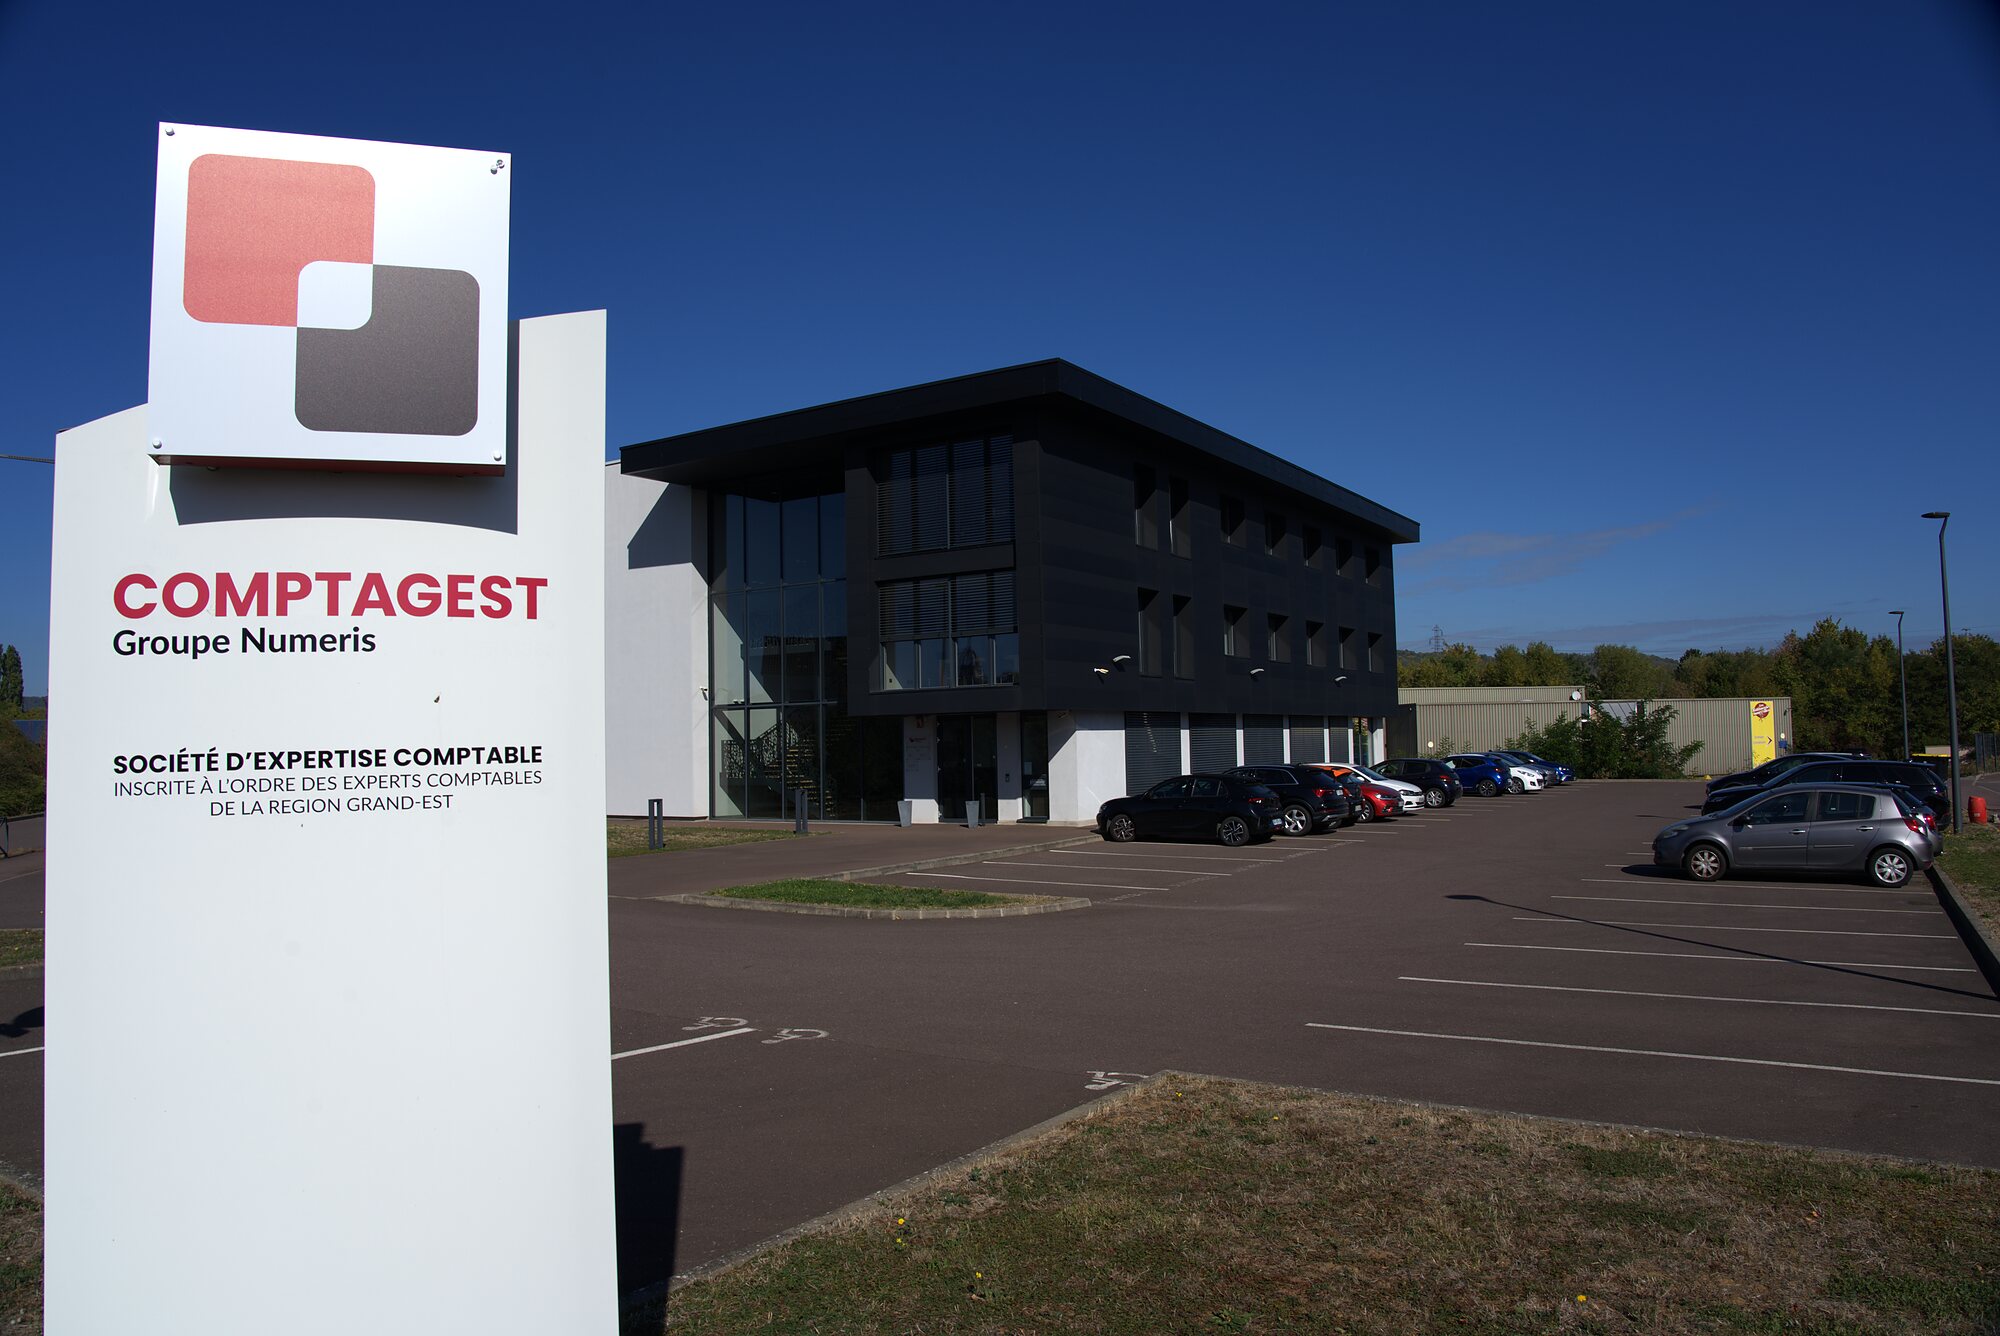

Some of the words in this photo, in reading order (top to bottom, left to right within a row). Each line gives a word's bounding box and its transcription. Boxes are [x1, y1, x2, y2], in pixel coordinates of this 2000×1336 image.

[113, 571, 549, 620] COMPTAGEST
[112, 629, 231, 660] Groupe
[241, 626, 376, 654] Numeris
[113, 746, 219, 775] SOCIÉTÉ
[226, 748, 387, 772] D’EXPERTISE
[393, 745, 543, 767] COMPTABLE
[114, 779, 196, 797] INSCRITE
[200, 775, 214, 795] À
[218, 777, 296, 794] L’ORDRE
[302, 776, 337, 792] DES
[343, 773, 422, 790] EXPERTS
[426, 770, 542, 788] COMPTABLES
[210, 801, 235, 817] DE
[241, 800, 264, 816] LA
[269, 798, 341, 815] REGION
[346, 794, 454, 812] GRAND-EST
